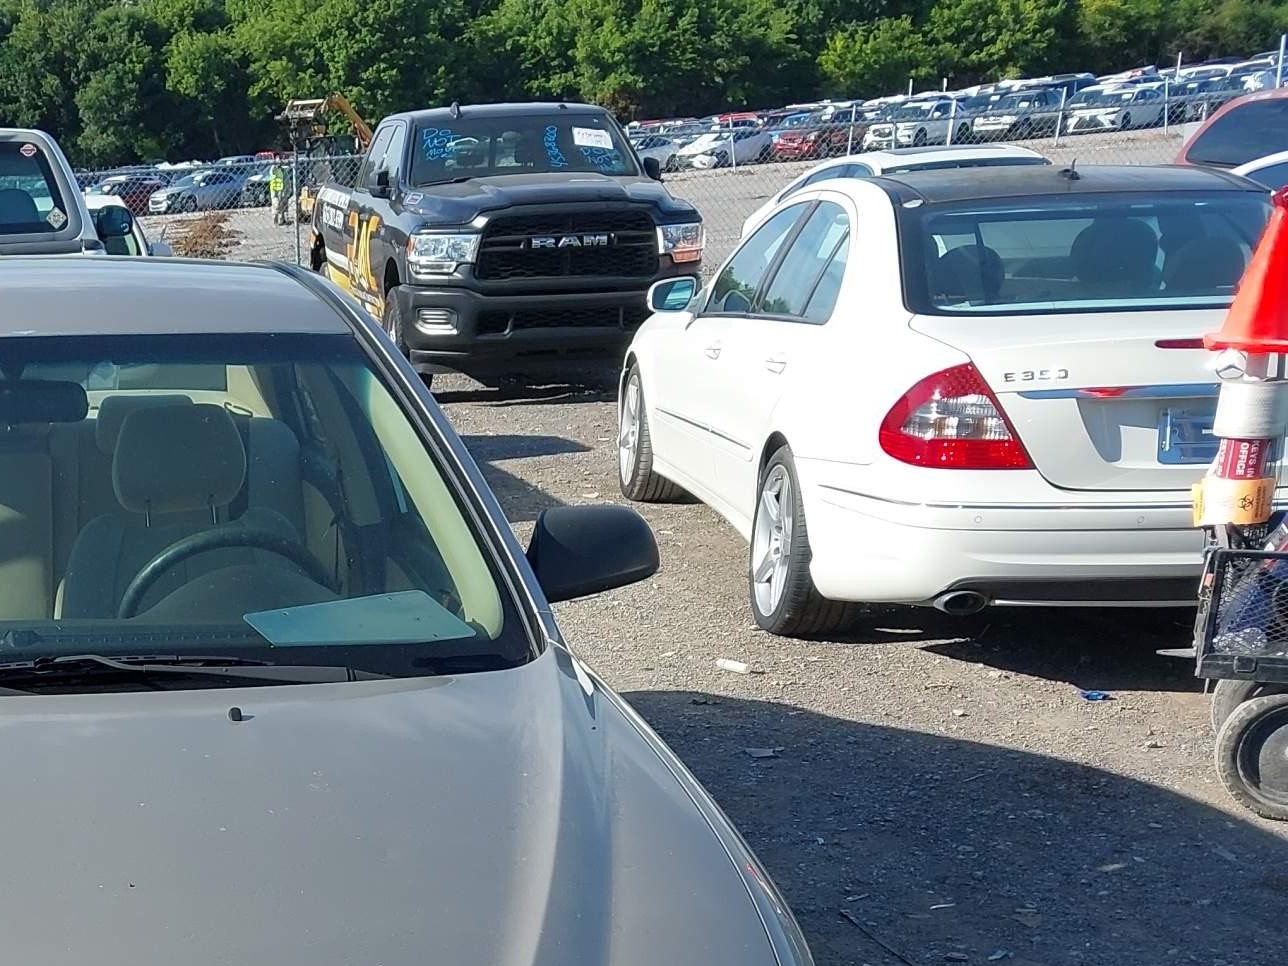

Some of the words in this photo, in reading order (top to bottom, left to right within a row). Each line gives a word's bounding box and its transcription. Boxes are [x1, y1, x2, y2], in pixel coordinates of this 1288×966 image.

[423, 128, 452, 139] DO
[423, 135, 462, 149] NOT
[531, 235, 608, 249] RAM
[1004, 372, 1016, 382] E
[1021, 368, 1069, 381] 350
[1236, 442, 1250, 476] OFFICE
[1249, 440, 1261, 465] KEYS
[1247, 467, 1255, 478] IN
